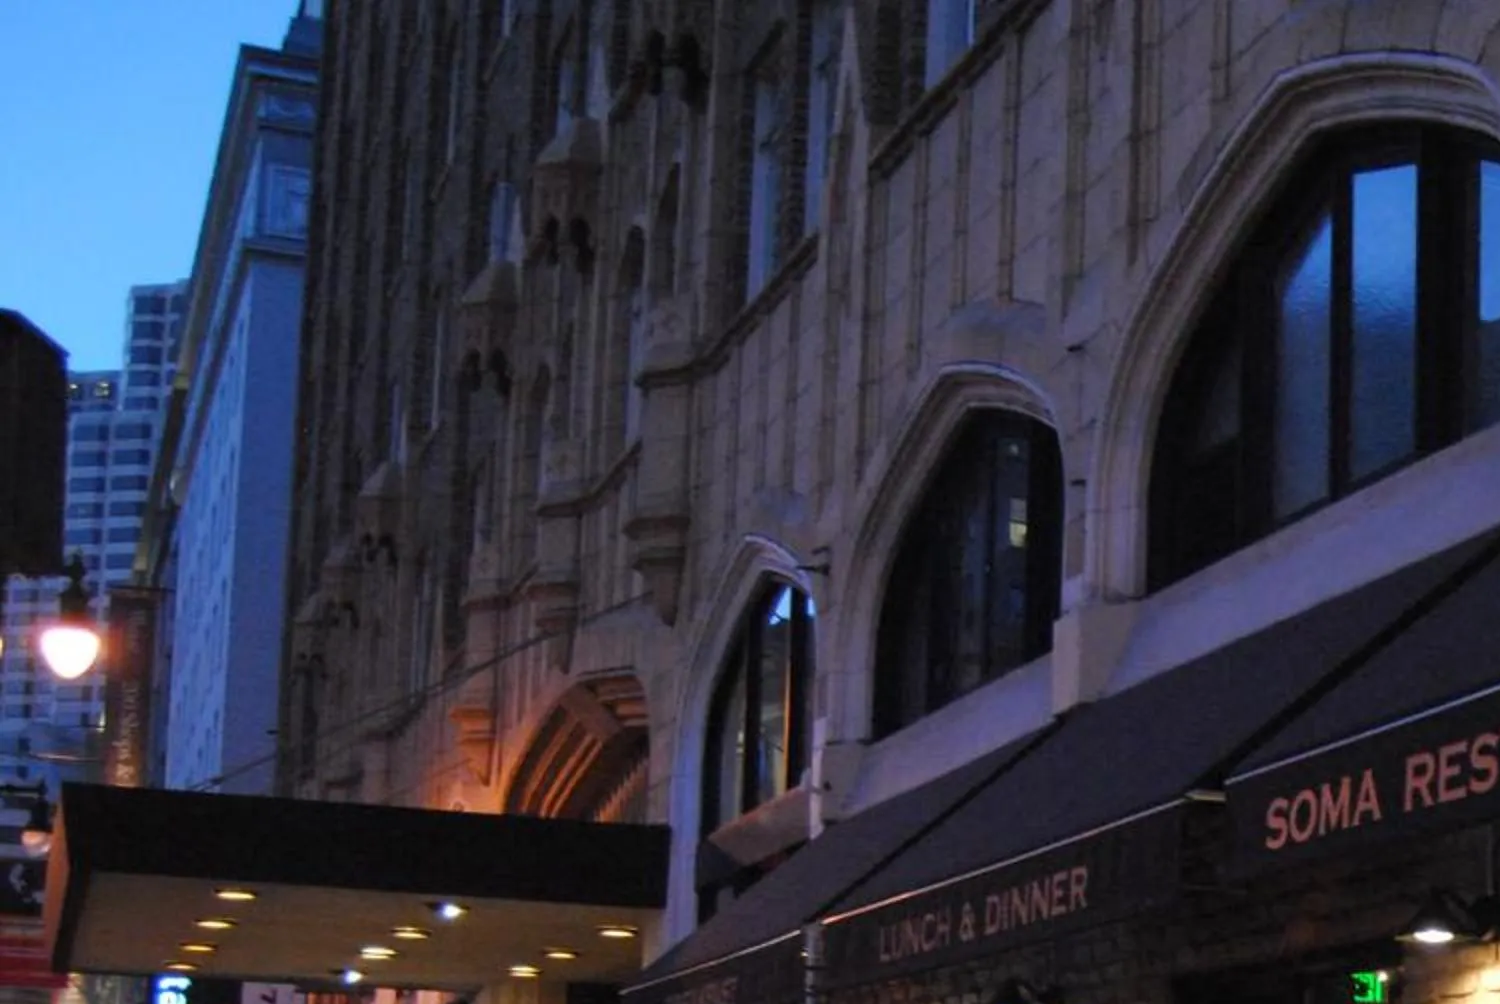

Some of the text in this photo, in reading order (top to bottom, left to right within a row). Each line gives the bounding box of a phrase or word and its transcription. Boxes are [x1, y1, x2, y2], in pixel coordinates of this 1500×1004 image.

[1264, 768, 1382, 851] SOMA
[879, 864, 1089, 962] LUNCH & DINNER
